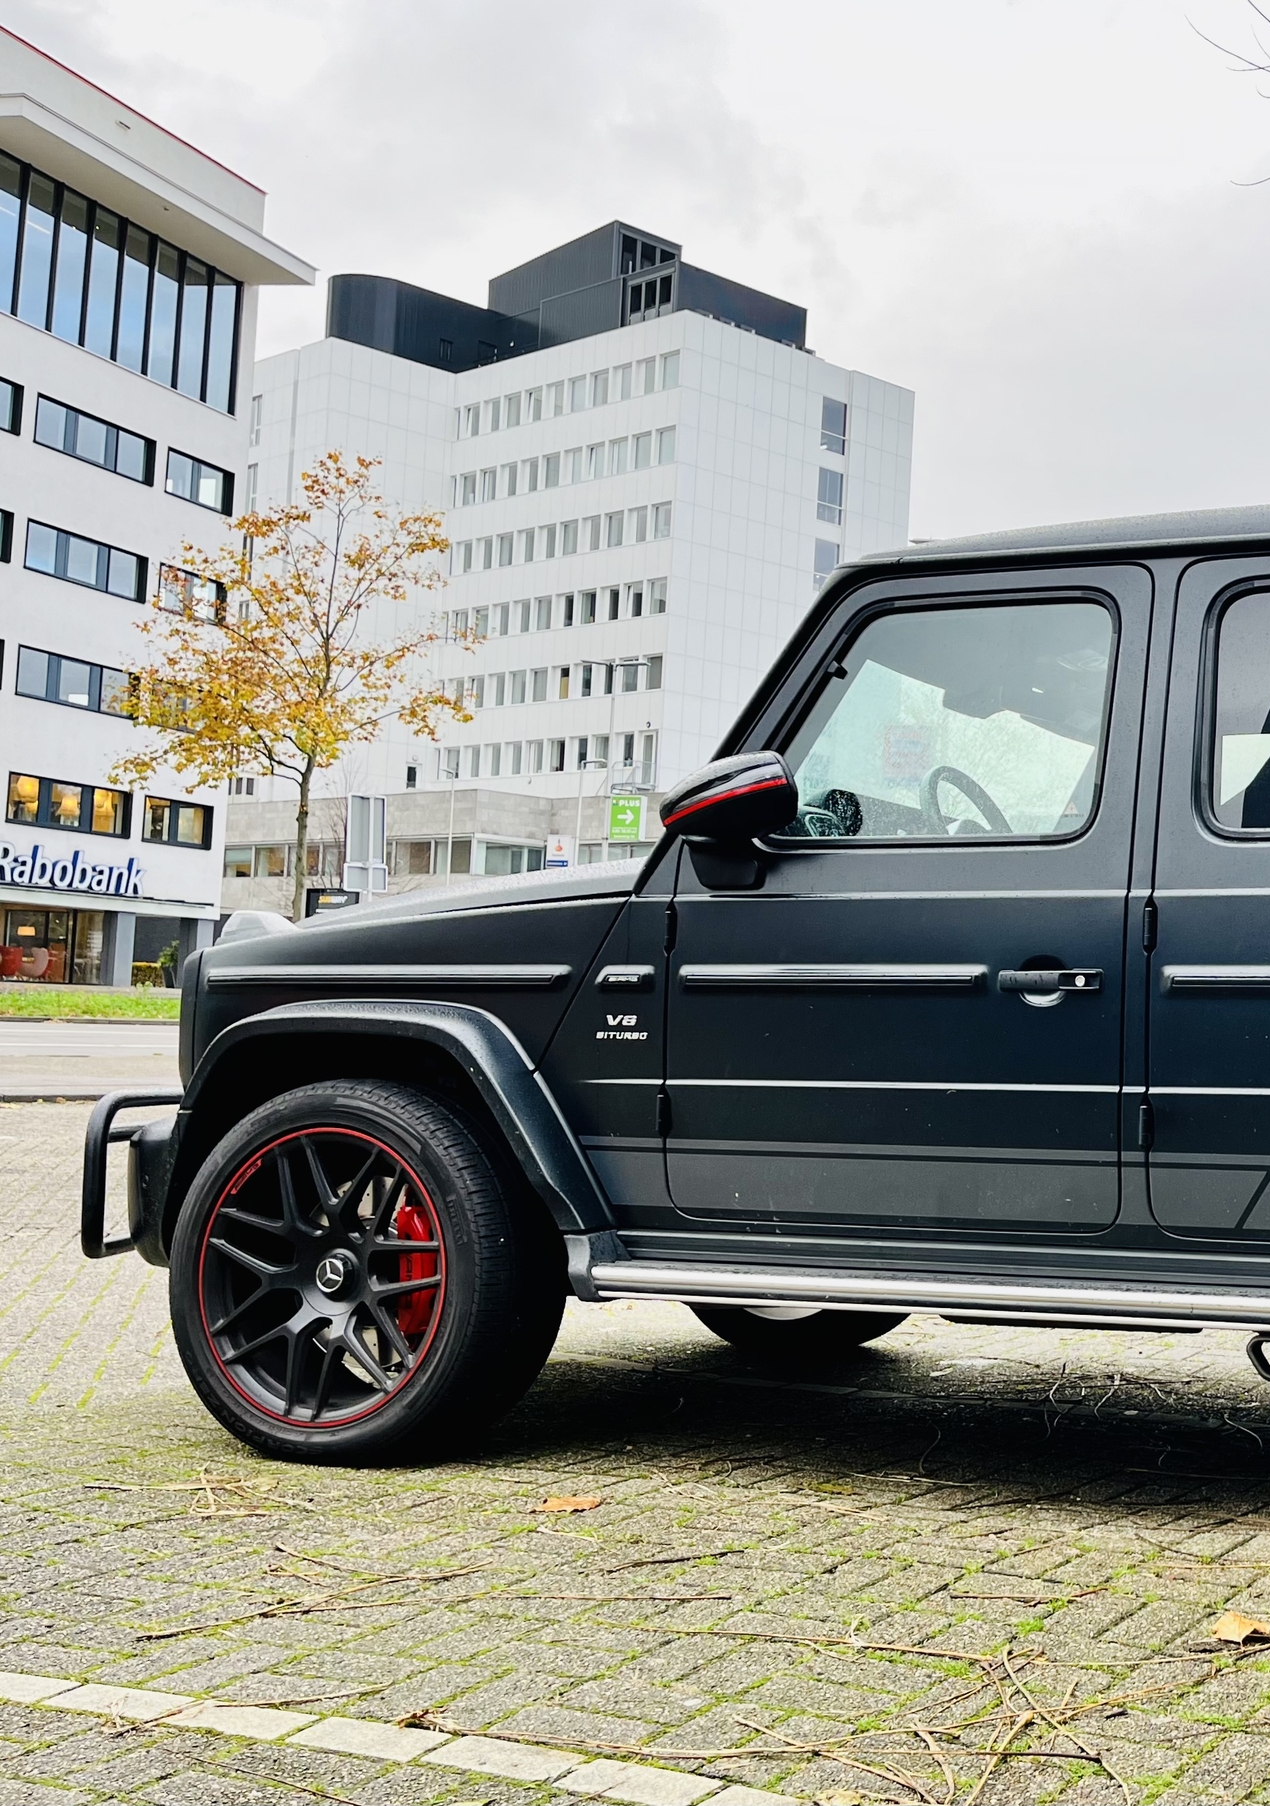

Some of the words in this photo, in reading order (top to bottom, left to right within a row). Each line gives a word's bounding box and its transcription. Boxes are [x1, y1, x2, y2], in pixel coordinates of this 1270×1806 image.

[618, 799, 640, 807] PLUS
[0, 841, 146, 896] Rabobank
[606, 1014, 637, 1026] V8
[595, 1031, 648, 1040] BITURBO
